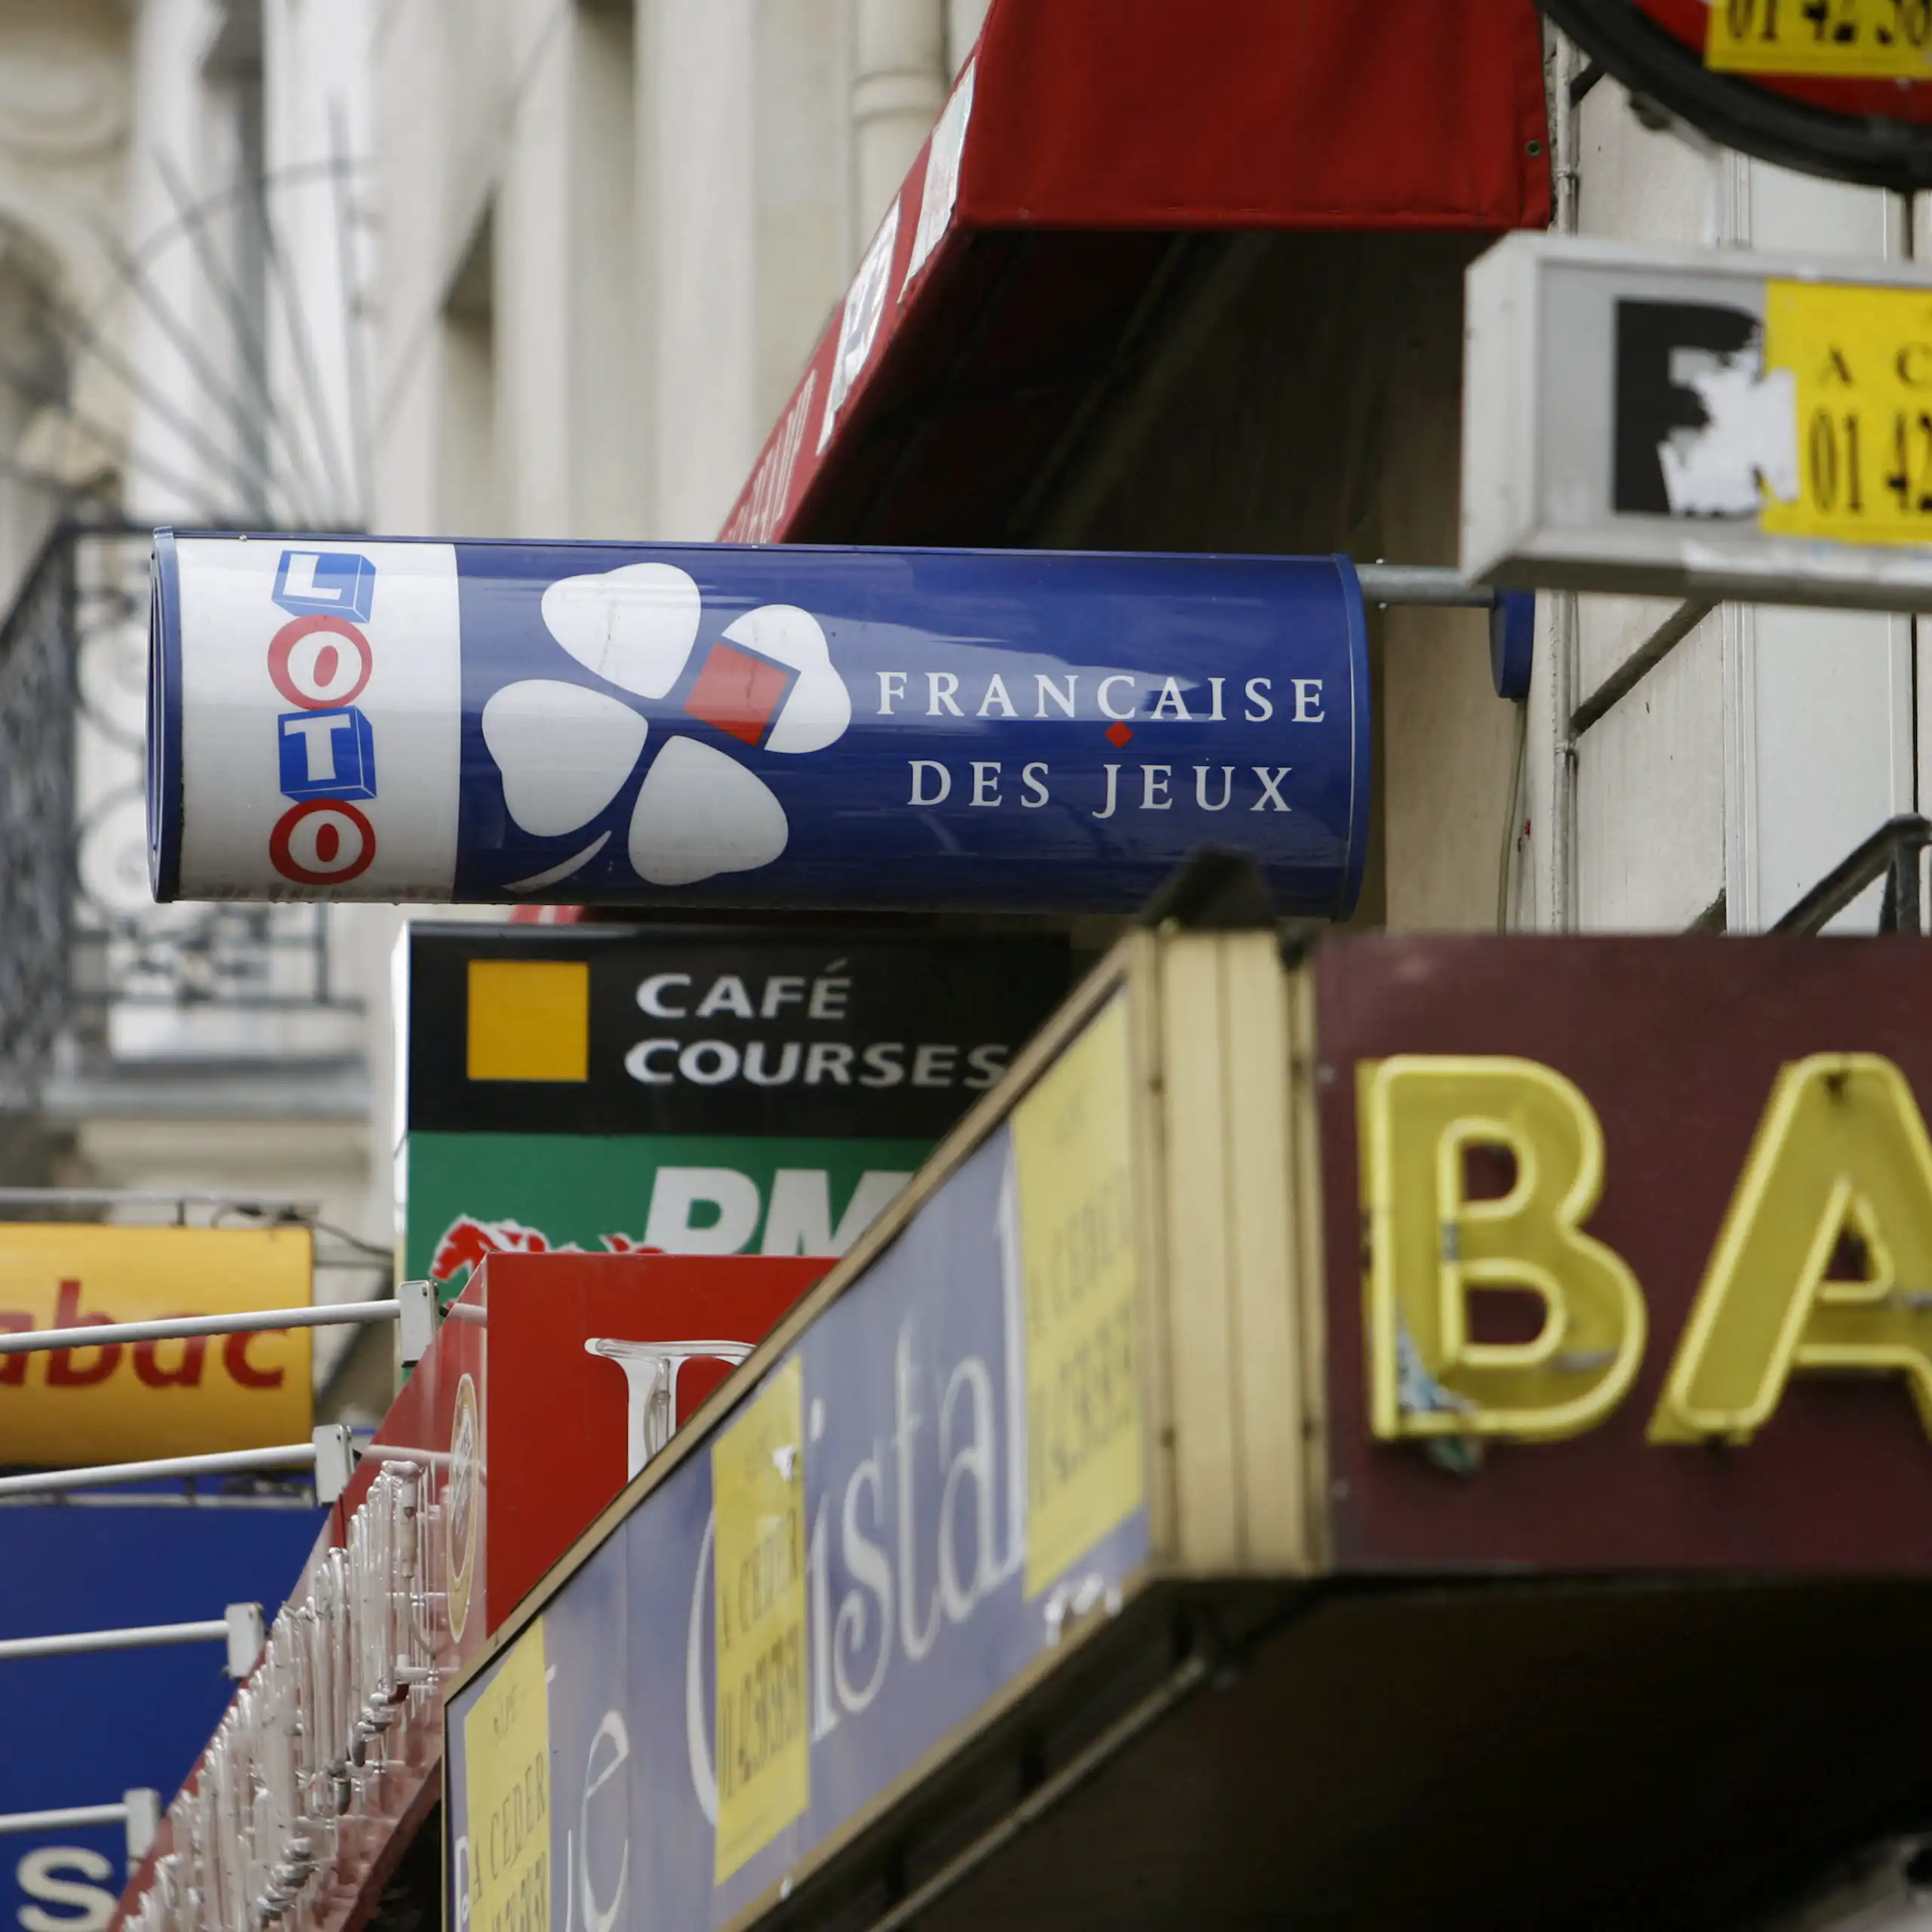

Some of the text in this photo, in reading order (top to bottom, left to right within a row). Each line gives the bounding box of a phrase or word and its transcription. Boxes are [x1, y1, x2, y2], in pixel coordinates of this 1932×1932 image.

[267, 549, 377, 885] LOTO
[907, 760, 1293, 819] DES JEUX
[635, 958, 851, 1020] CAFÉ
[624, 1038, 1008, 1090] COURSES
[1356, 1053, 1932, 1447] BA
